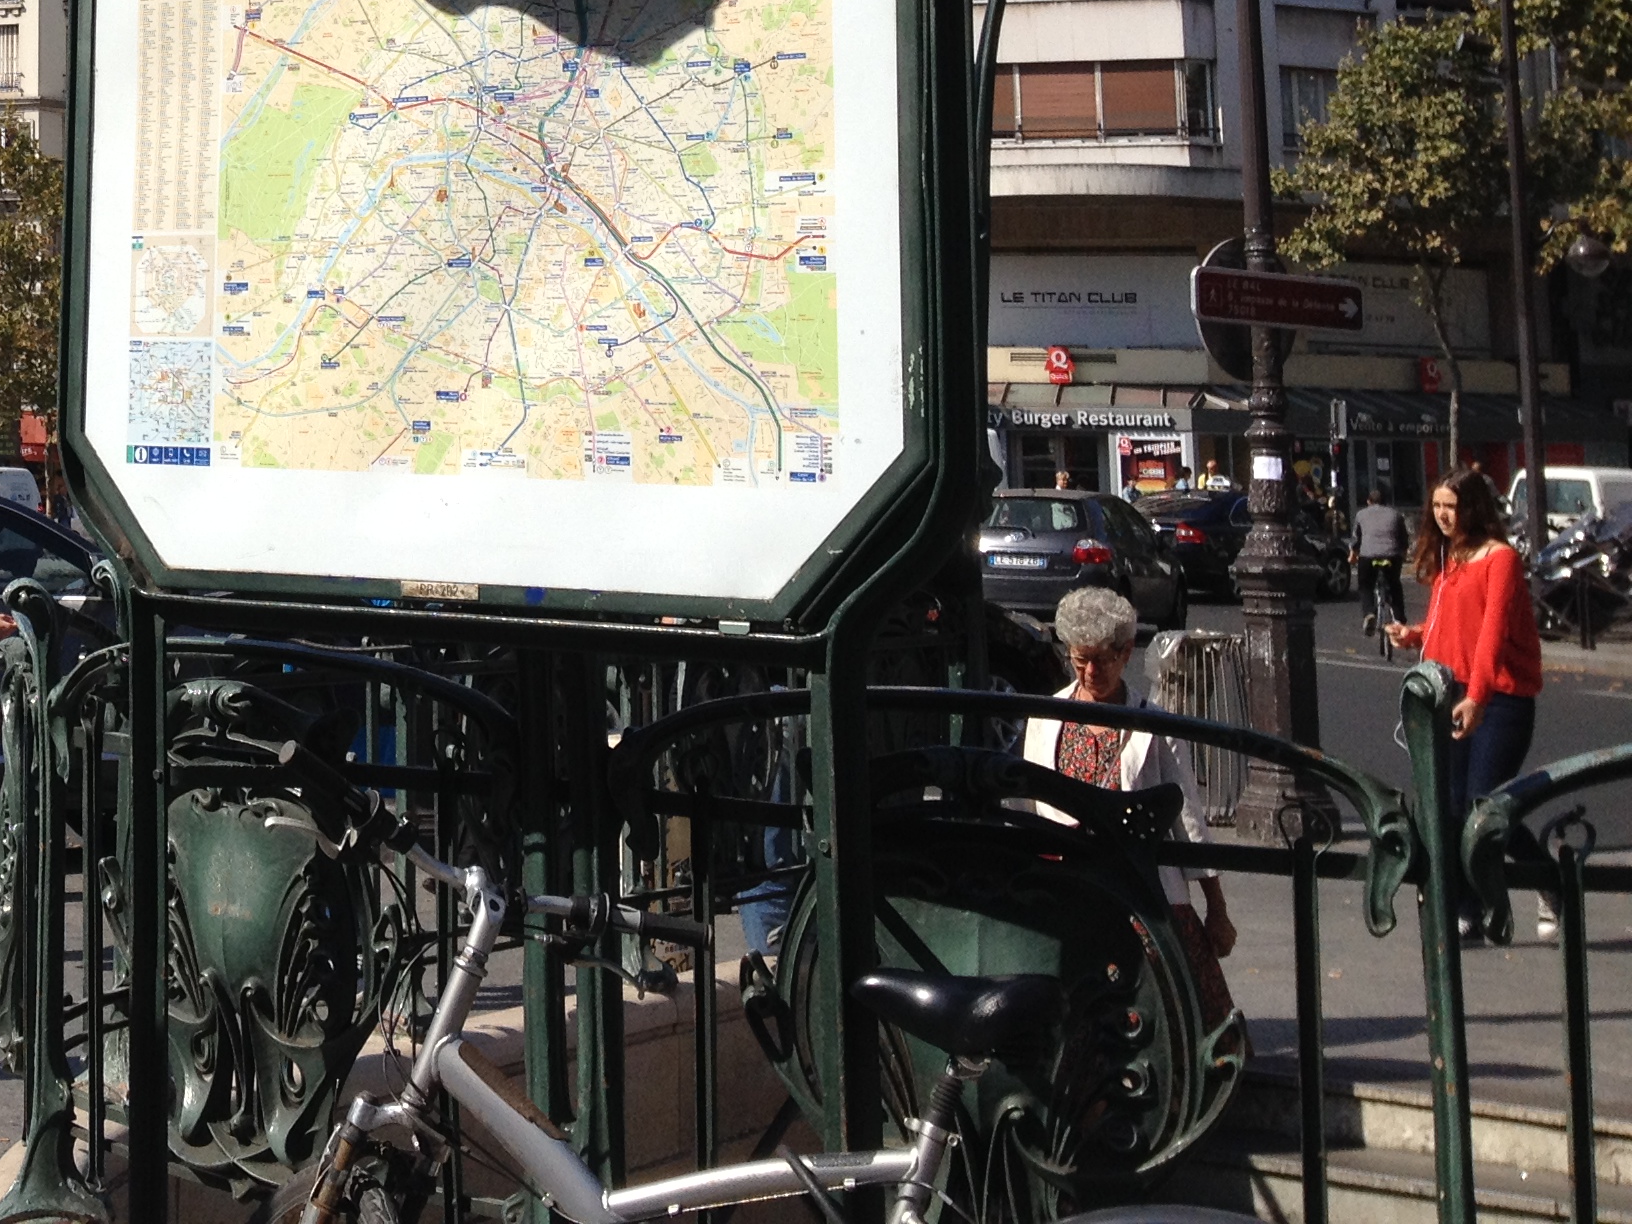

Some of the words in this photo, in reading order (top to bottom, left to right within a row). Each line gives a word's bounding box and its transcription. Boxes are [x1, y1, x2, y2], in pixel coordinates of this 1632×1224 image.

[1000, 292, 1024, 303] LE
[1030, 291, 1081, 304] TITAN
[1087, 292, 1138, 304] CLUB
[1050, 350, 1068, 369] Q
[1012, 409, 1069, 428] Burger
[1077, 410, 1171, 427] Restaurant
